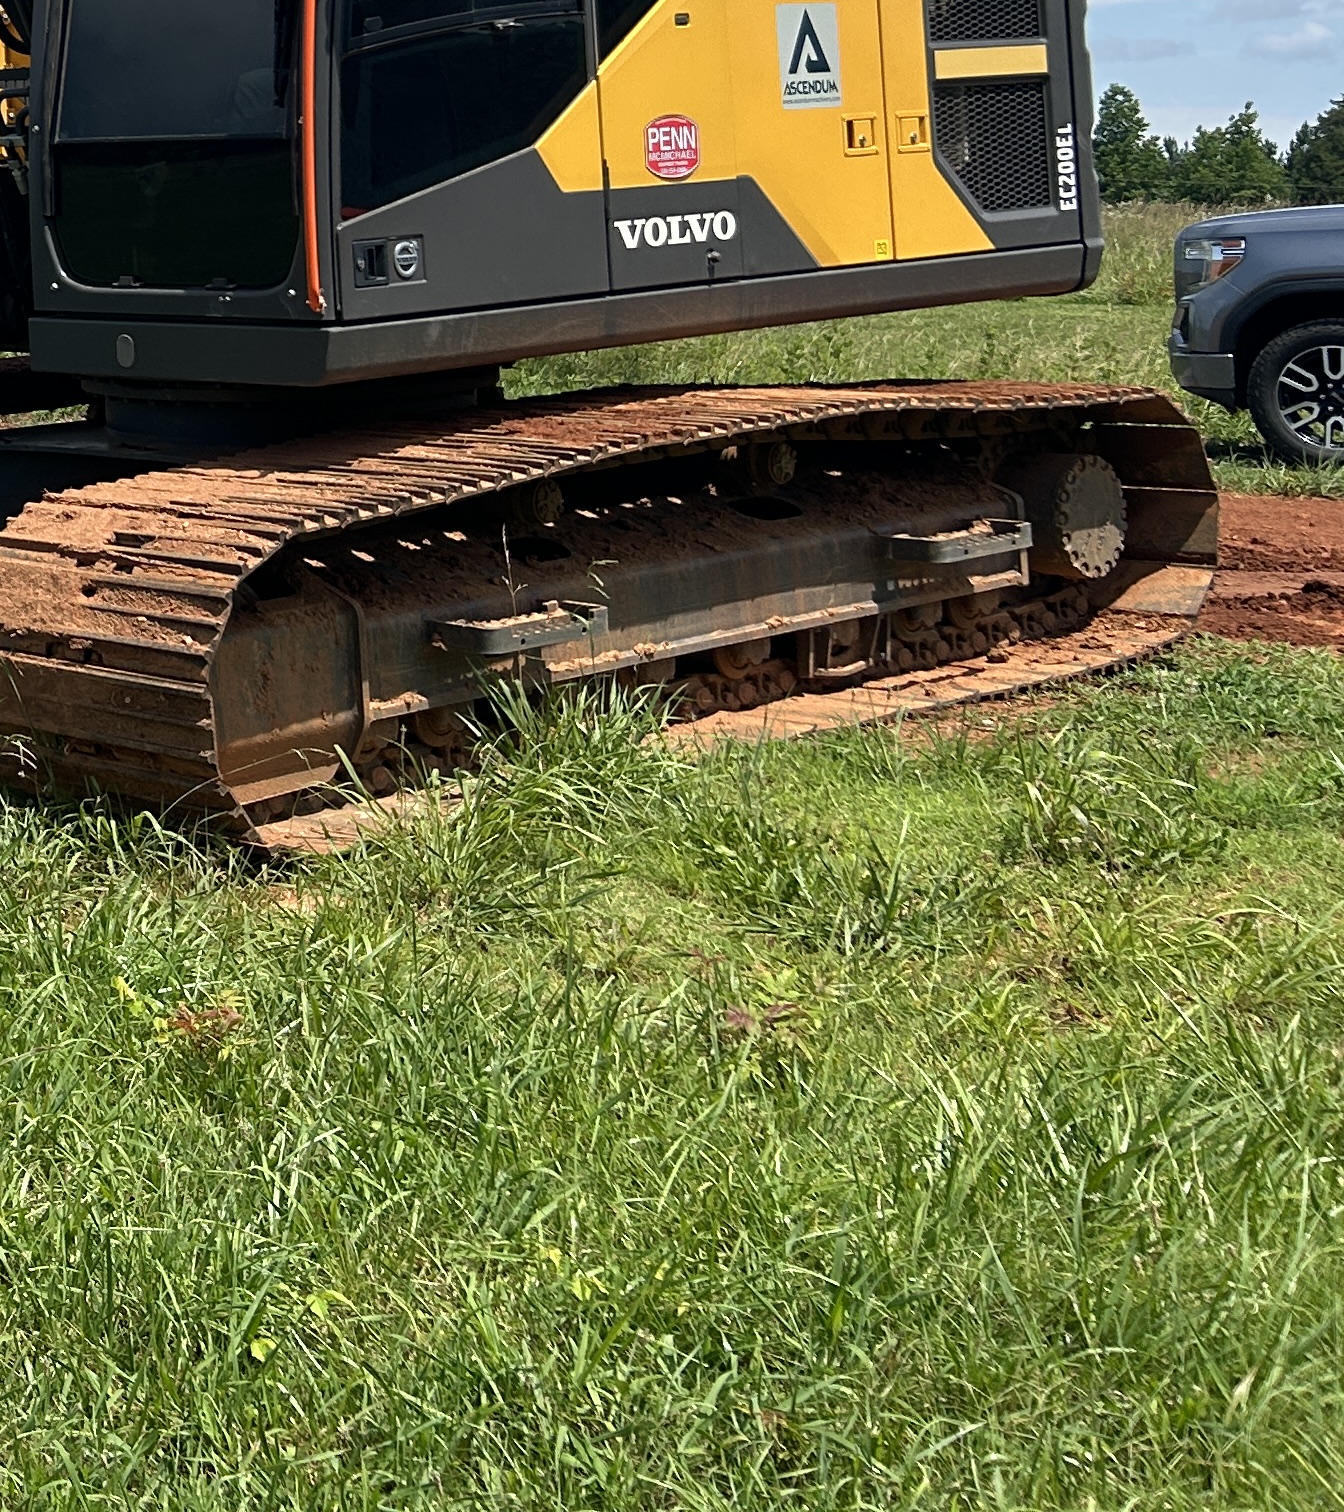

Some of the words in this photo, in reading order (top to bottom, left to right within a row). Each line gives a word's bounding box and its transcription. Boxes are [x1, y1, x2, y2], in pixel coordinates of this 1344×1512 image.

[784, 80, 838, 95] ASCENDUM
[648, 125, 696, 151] PENN
[1056, 123, 1077, 211] EC200EL
[614, 211, 736, 249] VOLVO
